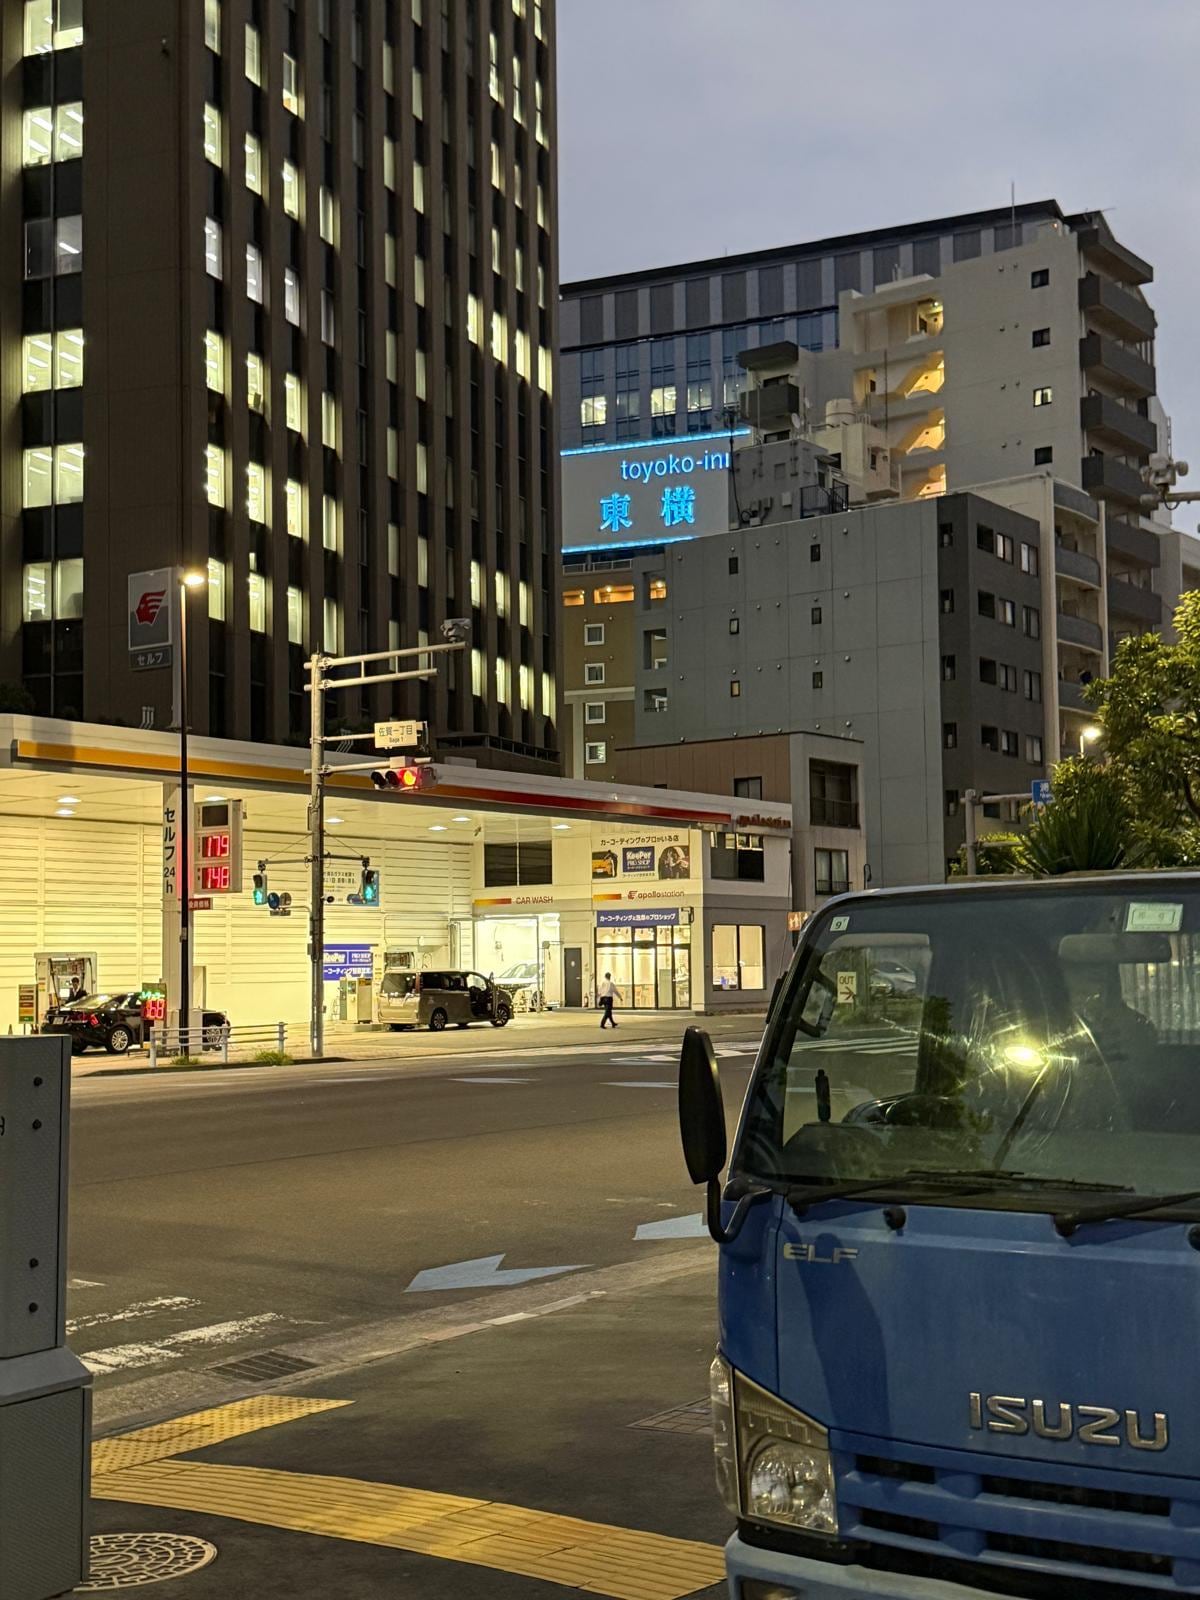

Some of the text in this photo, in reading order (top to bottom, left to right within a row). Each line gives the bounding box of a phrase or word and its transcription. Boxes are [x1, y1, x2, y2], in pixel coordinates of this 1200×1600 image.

[137, 652, 163, 666] セルフ
[207, 835, 230, 857] 179
[207, 866, 230, 889] 148
[515, 896, 553, 905] CAR WASH
[638, 889, 685, 901] apollostation
[839, 976, 854, 985] OUT
[783, 1242, 858, 1264] ELF
[969, 1391, 1169, 1451] ISUZU
